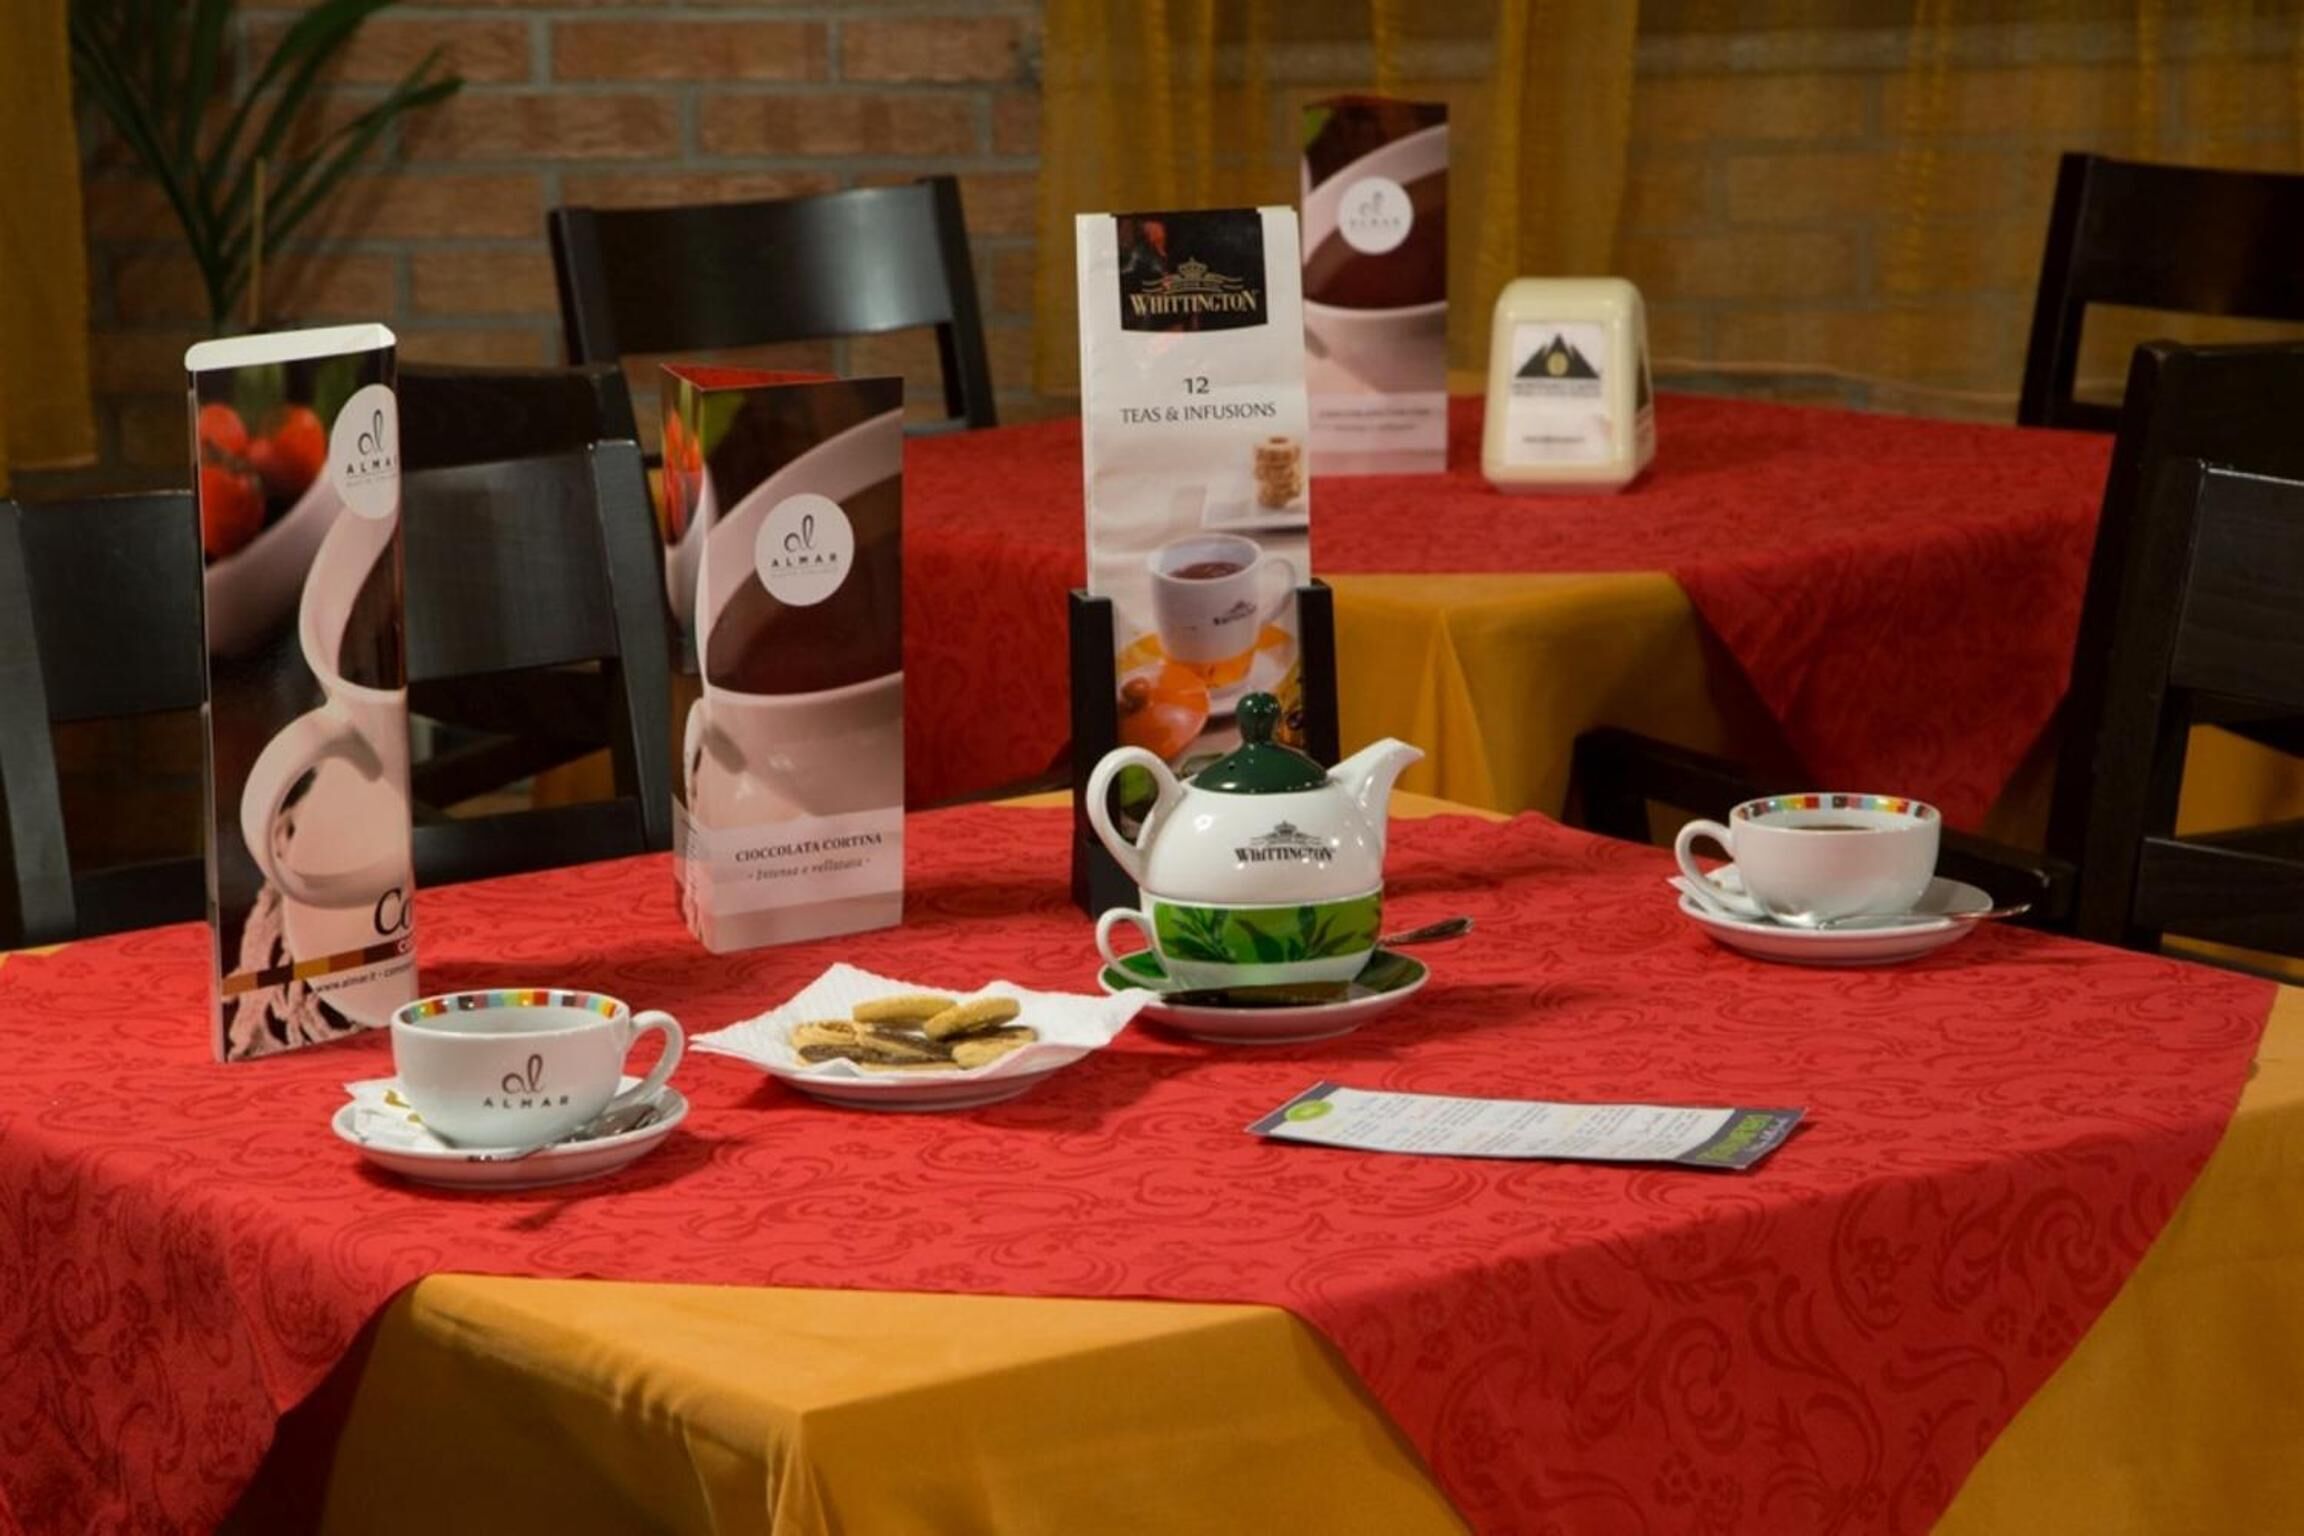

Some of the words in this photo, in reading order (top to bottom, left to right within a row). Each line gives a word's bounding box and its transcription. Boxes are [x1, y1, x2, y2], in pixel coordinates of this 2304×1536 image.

[1130, 289, 1257, 316] WHITTINGTON
[1184, 376, 1210, 394] 12
[1120, 406, 1161, 424] TEAS
[1166, 406, 1179, 422] &
[1184, 402, 1277, 421] INFUSIONS
[771, 552, 837, 568] ALMAR
[735, 841, 821, 863] CIOCCOLATA
[822, 831, 883, 852] CORTINA
[483, 1095, 569, 1109] ALMAR
